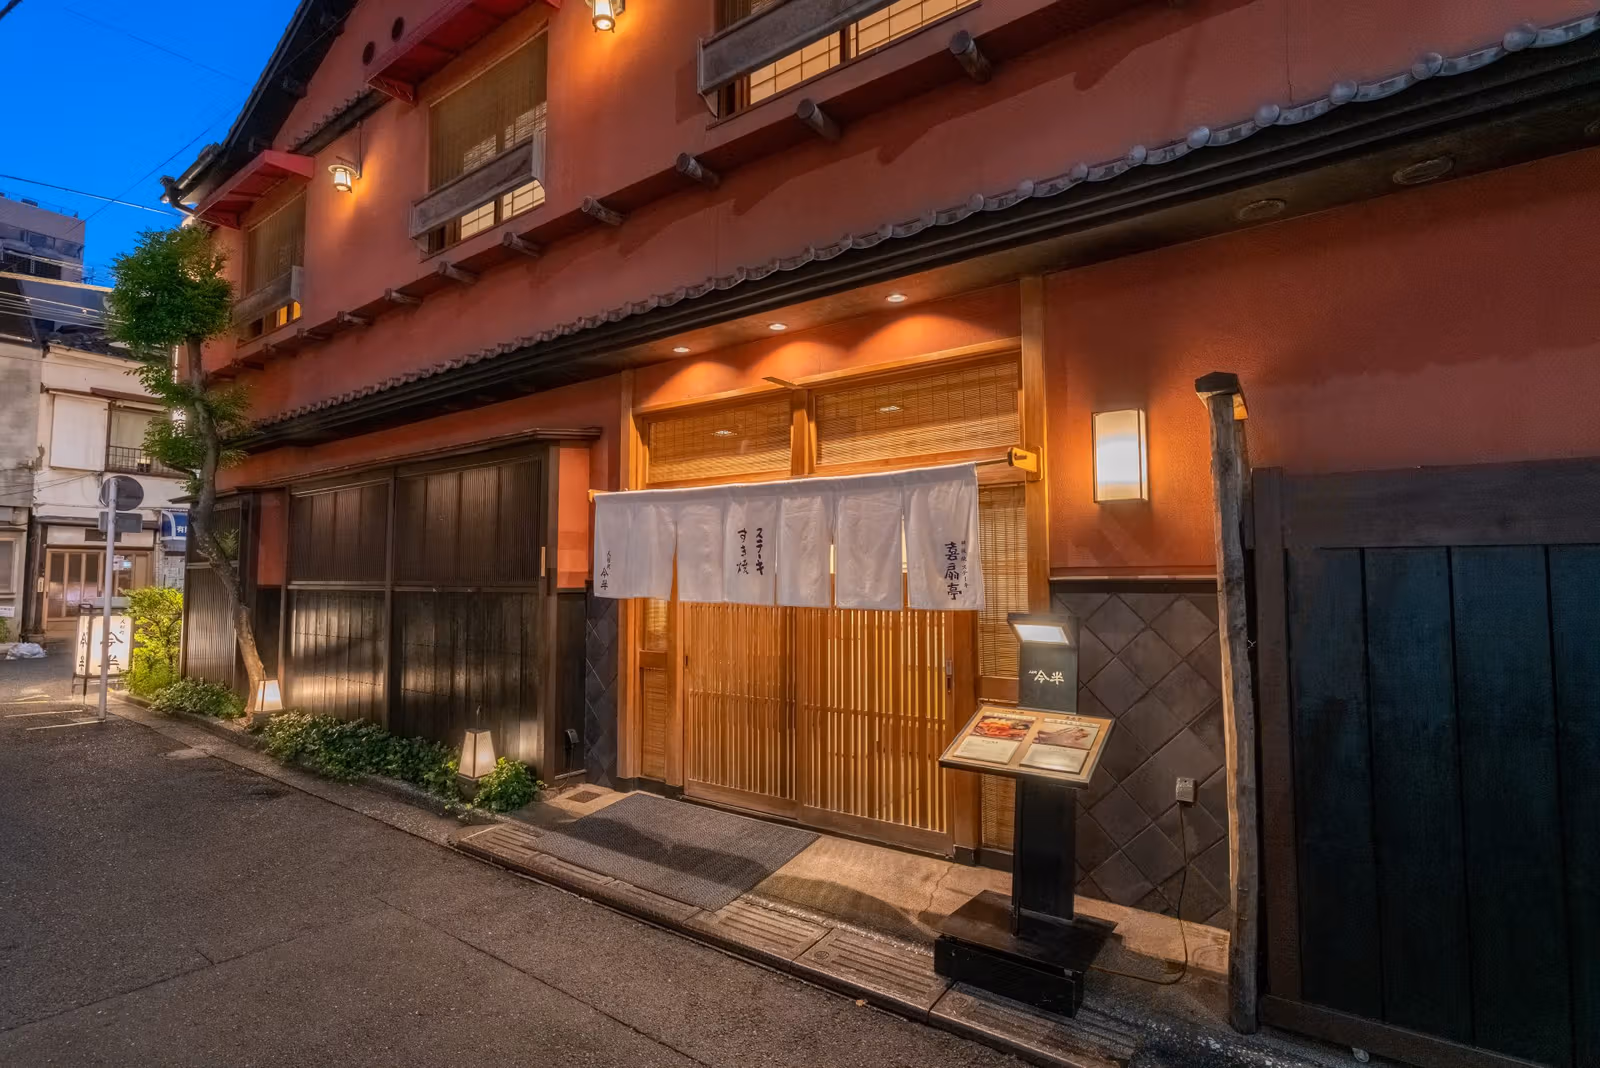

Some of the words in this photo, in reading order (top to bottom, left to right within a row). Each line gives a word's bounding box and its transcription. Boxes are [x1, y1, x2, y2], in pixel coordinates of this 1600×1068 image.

[756, 528, 764, 576] ステーキ
[945, 541, 962, 600] 喜扇亭
[1033, 669, 1065, 685] 今半
